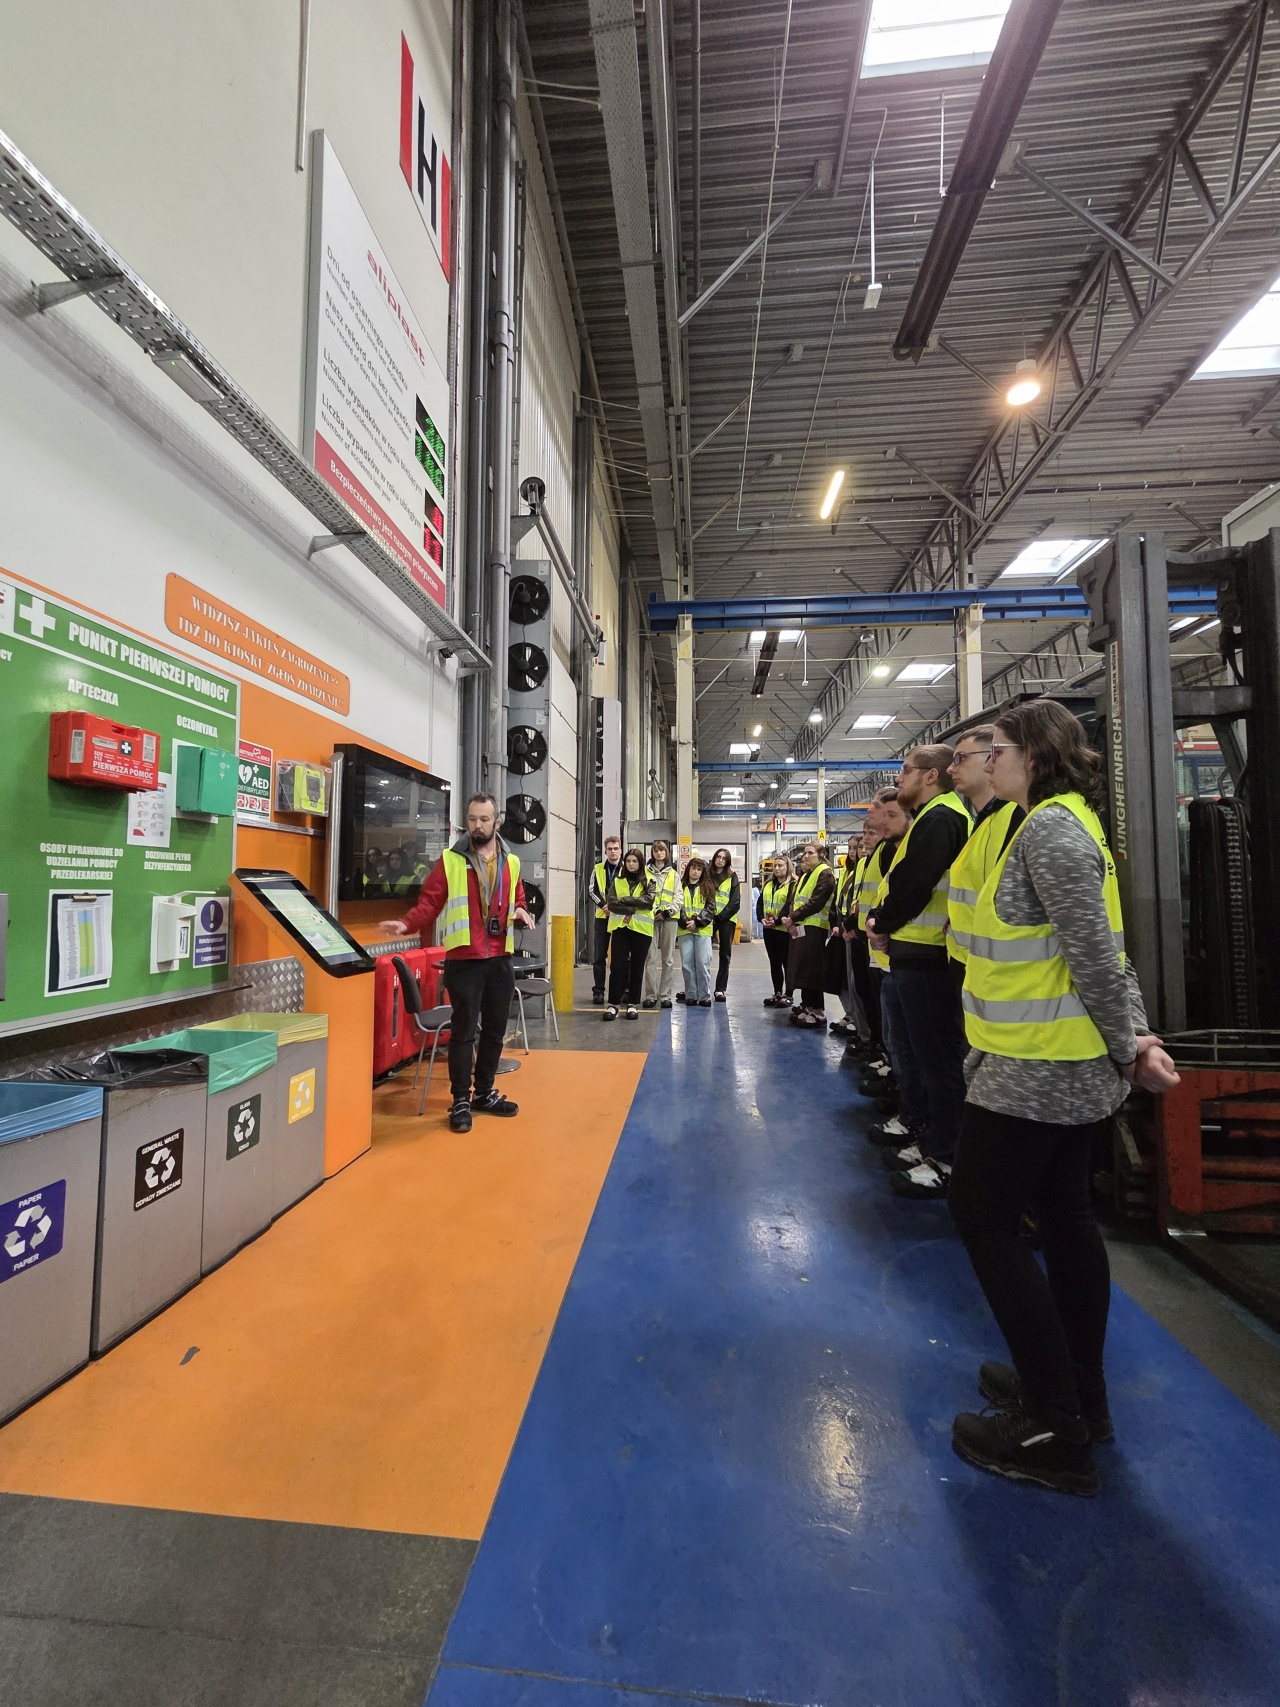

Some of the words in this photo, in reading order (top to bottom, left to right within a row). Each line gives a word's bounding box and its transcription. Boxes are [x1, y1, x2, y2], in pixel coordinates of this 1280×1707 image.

[417, 95, 437, 236] H
[327, 245, 340, 273] Dni
[341, 272, 350, 291] od
[351, 290, 383, 349] ostatniego
[385, 347, 408, 390] wypadku
[367, 249, 425, 367] aliplast
[326, 291, 343, 326] Nasz
[345, 324, 366, 362] rekord
[367, 360, 377, 379] dni
[378, 375, 388, 397] bez
[389, 394, 411, 434] wypadku
[323, 365, 345, 399] Number
[321, 410, 343, 443] Number
[324, 347, 345, 386] Liczba
[347, 384, 380, 435] wypadków
[382, 433, 387, 444] w
[388, 442, 399, 463] roku
[401, 459, 422, 496] bieżącym
[322, 393, 344, 430] Liczba
[346, 427, 379, 475] wypadków
[380, 472, 386, 482] w
[387, 481, 398, 500] roku
[400, 498, 421, 530] ubiegłym
[331, 459, 381, 526] Bezpieczeństwo
[381, 520, 392, 539] jest
[393, 535, 412, 561] naszym
[413, 558, 438, 591] priorytetem
[192, 595, 240, 633] WIDZISZ
[0, 648, 12, 661] CY
[68, 622, 118, 658] PUNKT
[120, 643, 185, 685] PIERWSZEJ
[187, 672, 229, 703] POMOCY
[204, 629, 220, 648] DO
[224, 639, 266, 669] KIOSKU
[67, 678, 119, 706] APTECZKA
[176, 714, 218, 738] OCZOMYJKA
[92, 761, 128, 775] PIERWSZA
[129, 768, 154, 779] POMOC
[252, 776, 269, 789] AED
[1112, 718, 1127, 860] JUNGHEINRICH
[776, 819, 782, 830] H
[40, 842, 67, 853] OSOBY
[67, 845, 113, 856] UPRAWNIONE
[114, 848, 124, 857] DO
[46, 856, 88, 867] UDZIELANIA
[89, 858, 118, 868] POMOCY
[51, 869, 113, 880] PRZEDLEKARSKIEJ
[142, 1141, 163, 1155] GENERAL
[164, 1133, 179, 1144] WASTE
[18, 1193, 42, 1208] PAPER
[135, 1193, 155, 1208] ODPADY
[13, 1253, 39, 1271] PAPIER
